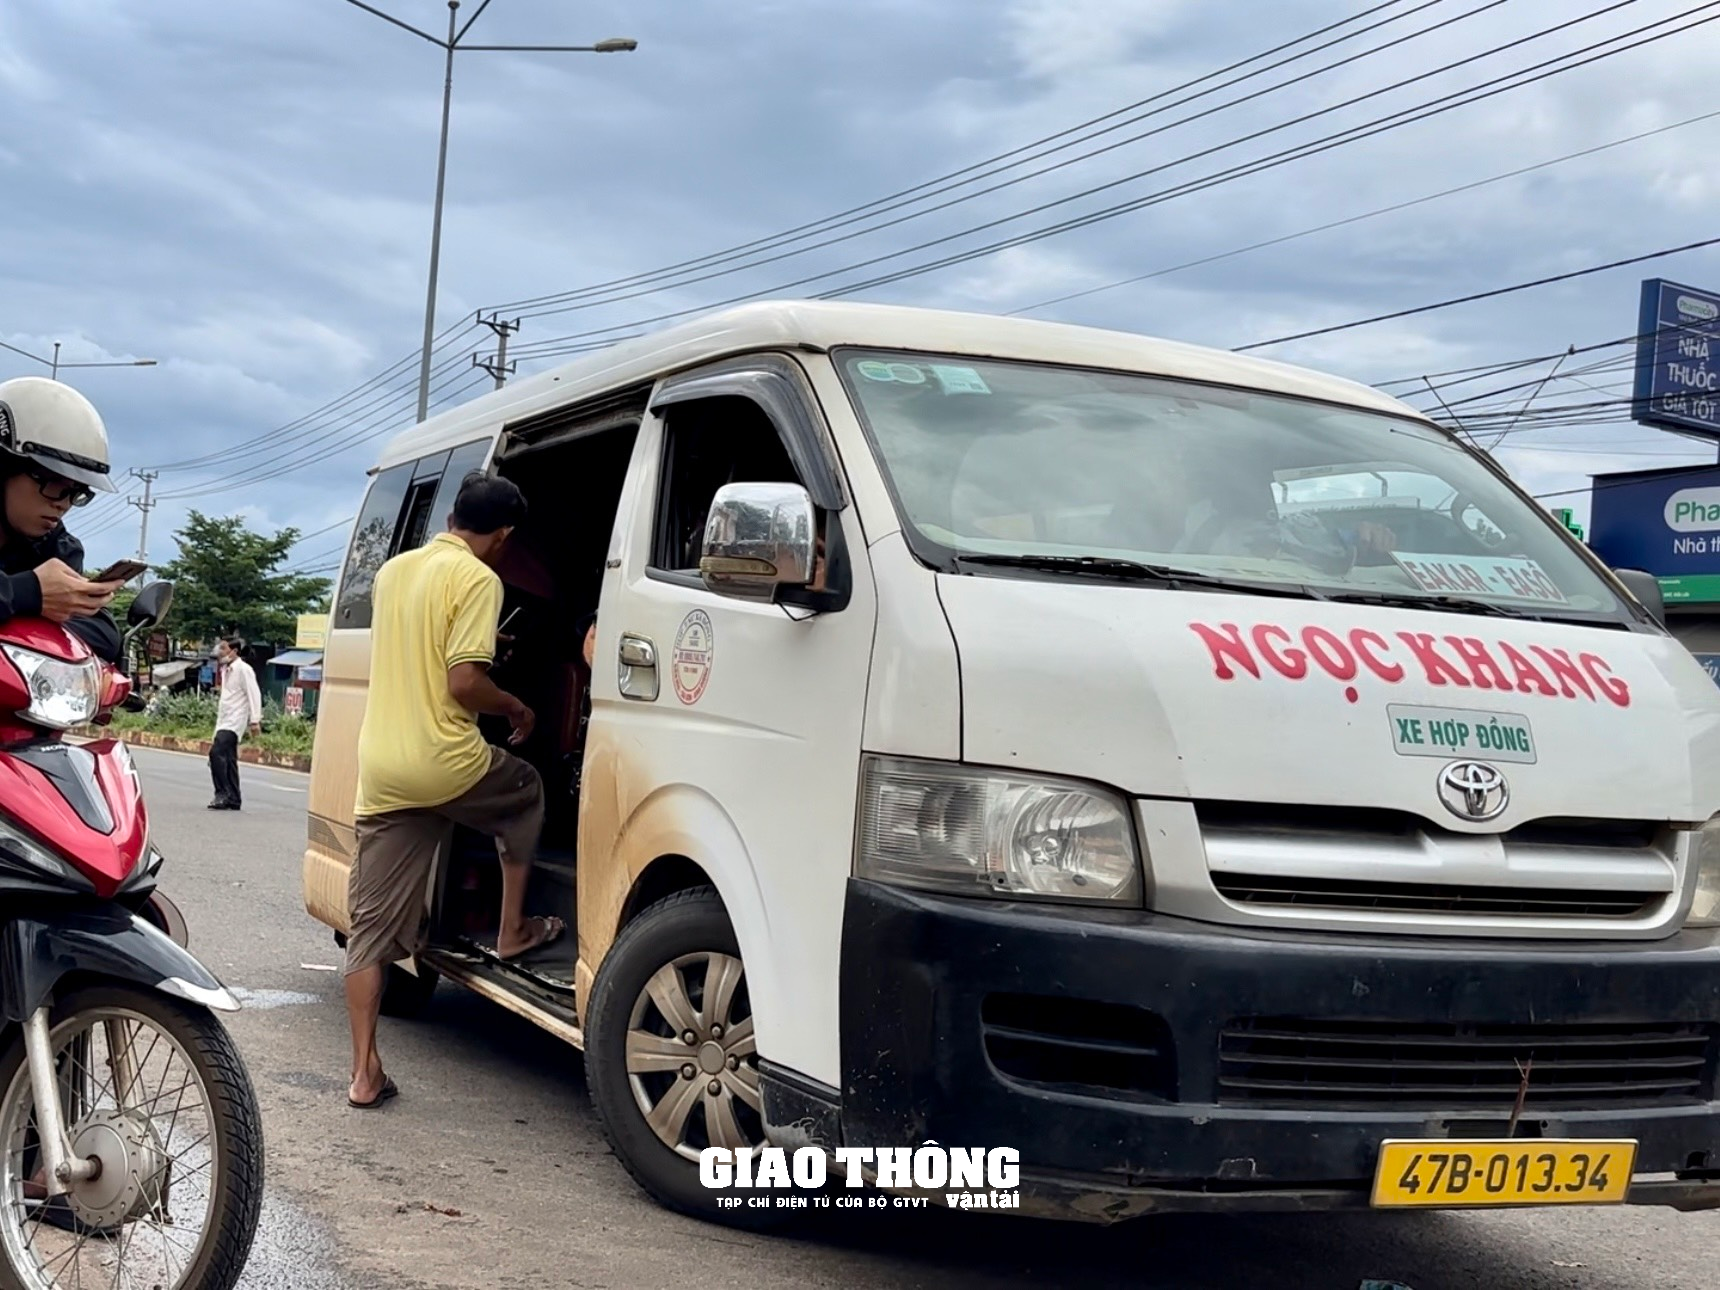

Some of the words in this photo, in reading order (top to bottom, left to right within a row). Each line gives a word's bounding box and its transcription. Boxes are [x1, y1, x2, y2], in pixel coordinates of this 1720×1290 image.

[1678, 336, 1710, 361] NHÀ
[1667, 361, 1717, 391] THUỐC
[1673, 537, 1706, 554] Nhà
[1403, 560, 1495, 593] EAKAR
[1188, 622, 1405, 703] NGỌC
[1396, 631, 1630, 707] KHANG
[1396, 718, 1424, 744] XE
[1428, 718, 1470, 752] HỢP
[1475, 716, 1531, 753] ĐỒNG
[1399, 1153, 1611, 1194] 47B-013.34
